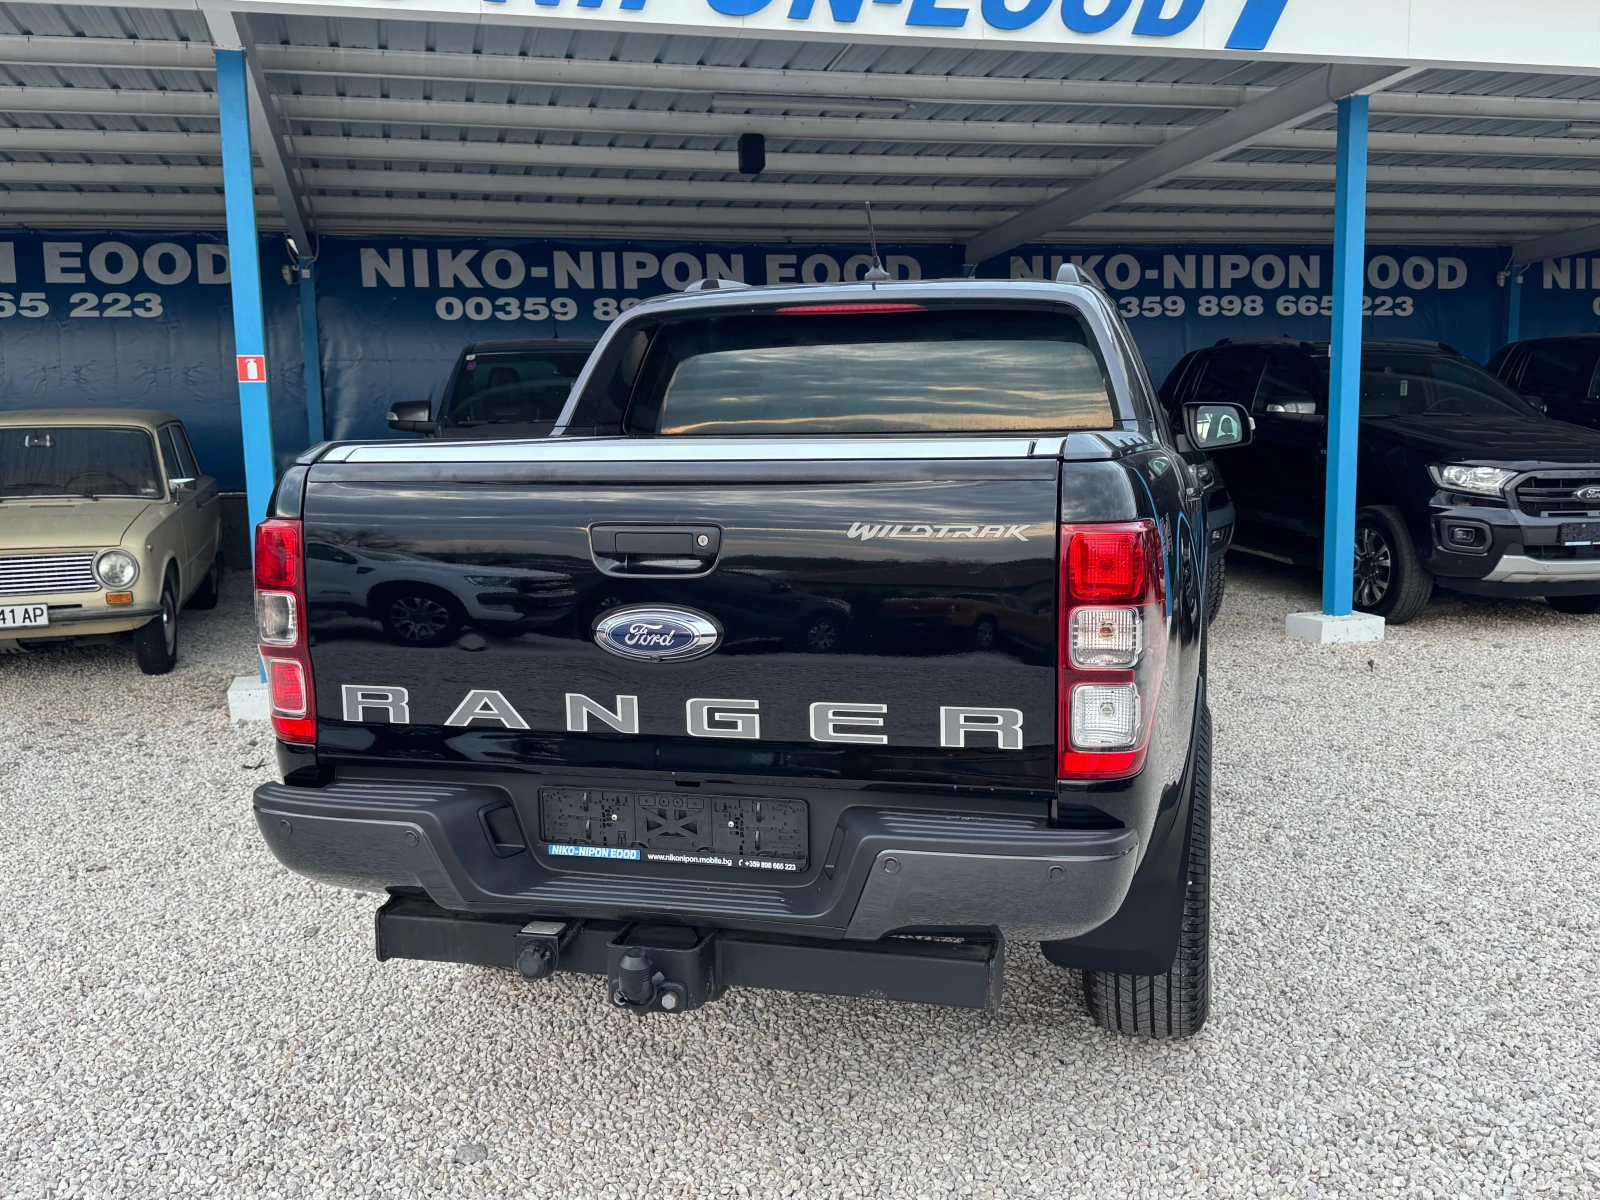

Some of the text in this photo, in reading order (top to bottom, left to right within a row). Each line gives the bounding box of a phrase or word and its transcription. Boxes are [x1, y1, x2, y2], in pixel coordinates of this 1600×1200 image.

[42, 241, 232, 285] EOOD
[360, 247, 745, 291] NIKO-NIPON
[1362, 255, 1468, 290] OOD
[69, 292, 164, 318] 223
[435, 296, 578, 321] 00359
[1197, 295, 1265, 317] 898
[1276, 295, 1333, 316] 665
[847, 522, 1031, 541] WILDTRAK
[22, 607, 44, 624] AP
[625, 623, 675, 647] Ford
[341, 684, 1024, 750] RANGER
[551, 844, 637, 860] NIKO-NIPON EOOD
[647, 853, 733, 866] www.nikonipon.mobile.bg
